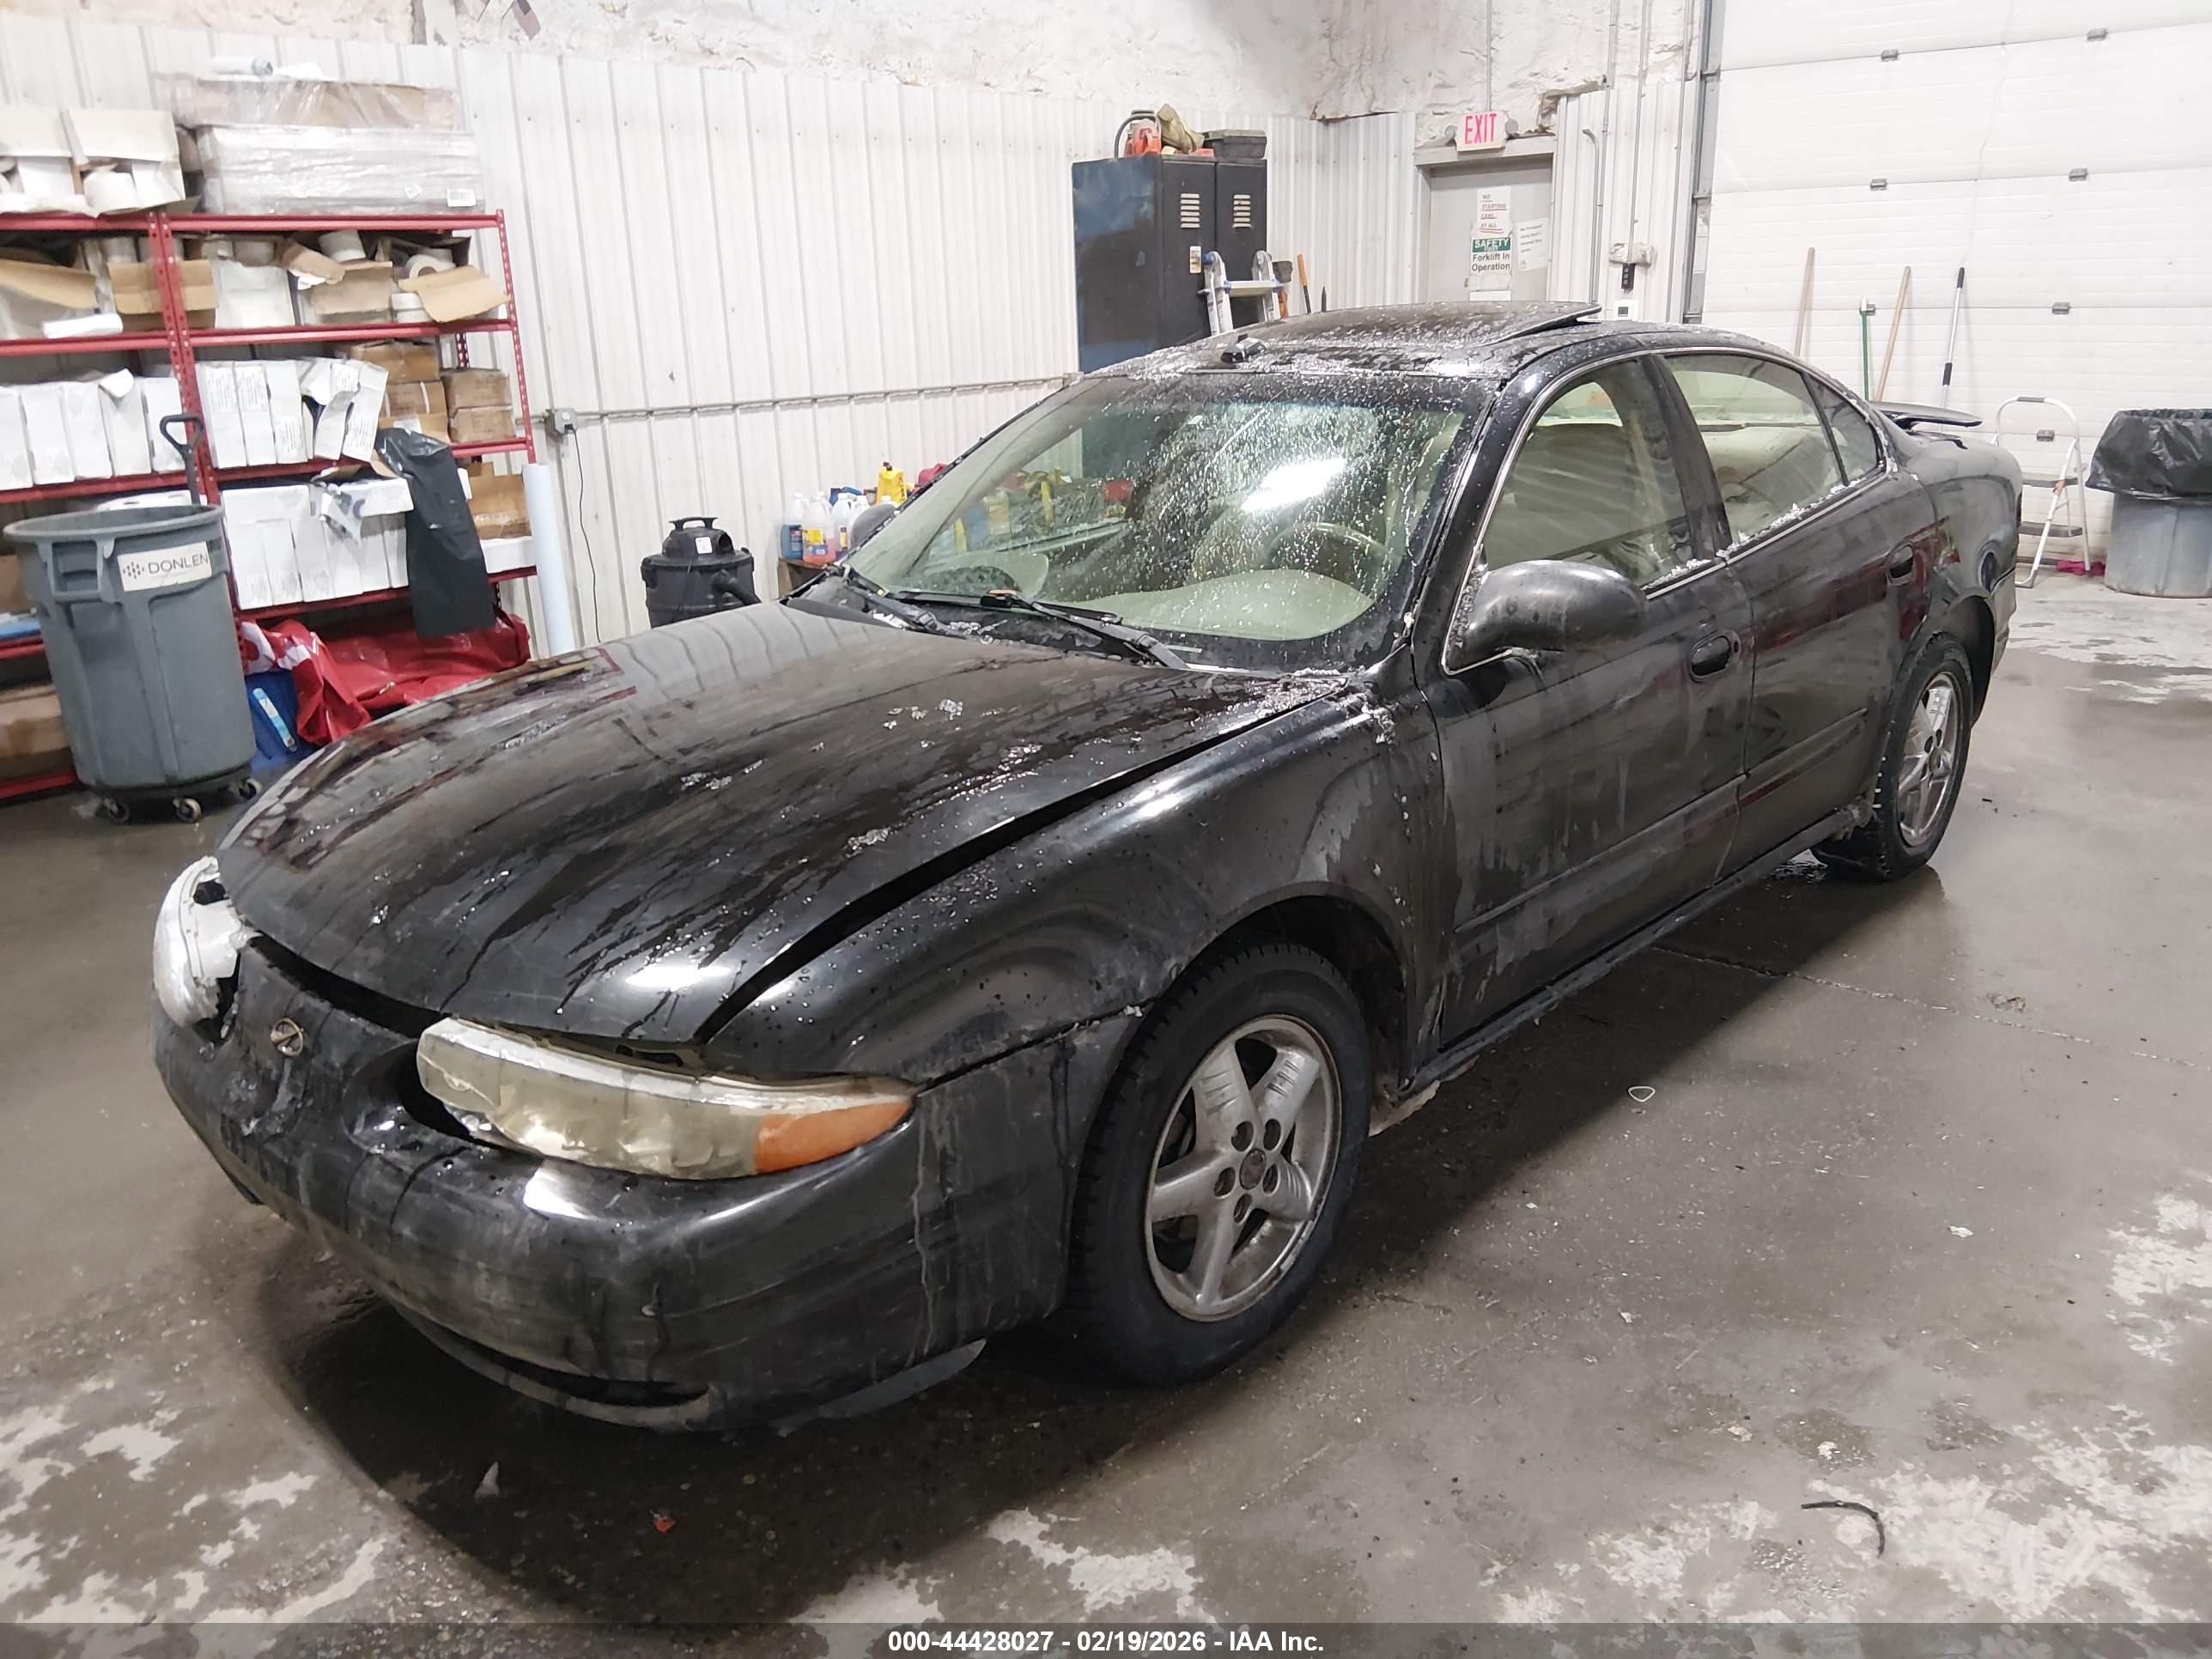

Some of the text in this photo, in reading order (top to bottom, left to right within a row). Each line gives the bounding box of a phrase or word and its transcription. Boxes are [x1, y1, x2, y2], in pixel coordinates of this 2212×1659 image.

[1465, 113, 1497, 144] EXIT
[1474, 238, 1510, 248] SAFETY
[1473, 252, 1500, 262] Forklift
[1472, 263, 1510, 272] Operation
[148, 553, 209, 574] DONLEN
